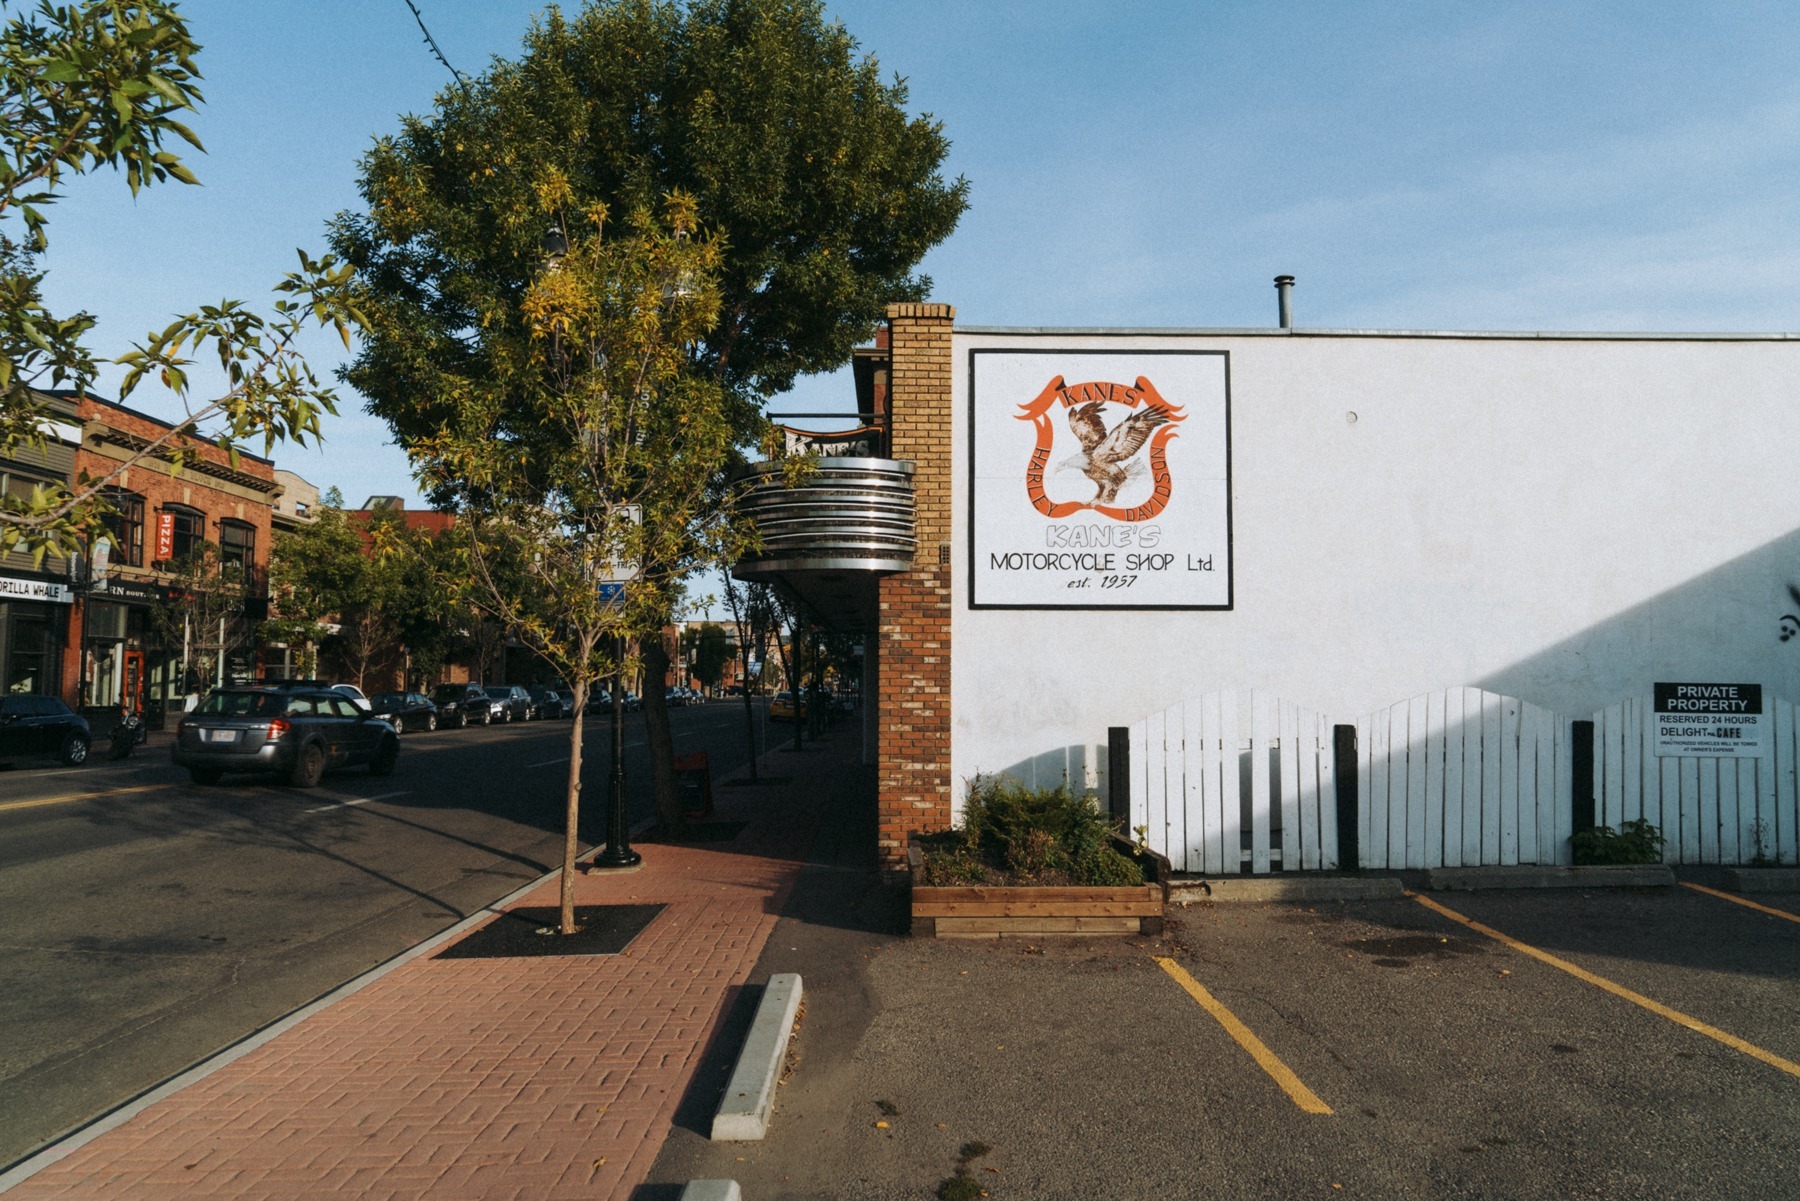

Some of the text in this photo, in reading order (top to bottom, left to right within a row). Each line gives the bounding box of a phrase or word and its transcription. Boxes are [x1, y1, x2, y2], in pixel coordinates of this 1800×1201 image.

[1062, 382, 1138, 407] KANES
[1027, 447, 1058, 517] HARLEY
[1125, 446, 1172, 522] DAVIDSON
[160, 514, 171, 554] PIZZA
[1046, 525, 1161, 548] KANE'S
[991, 553, 1116, 571] MOTORCYCLE
[1126, 553, 1174, 571] SHOP
[1067, 575, 1138, 589] est. 1957
[33, 585, 59, 598] WHALE
[1677, 686, 1738, 698] PRIVATE
[1667, 699, 1748, 711] PROPERTY
[1660, 715, 1757, 725] RESERVED 24 HOURS
[1716, 727, 1741, 739] CAFE
